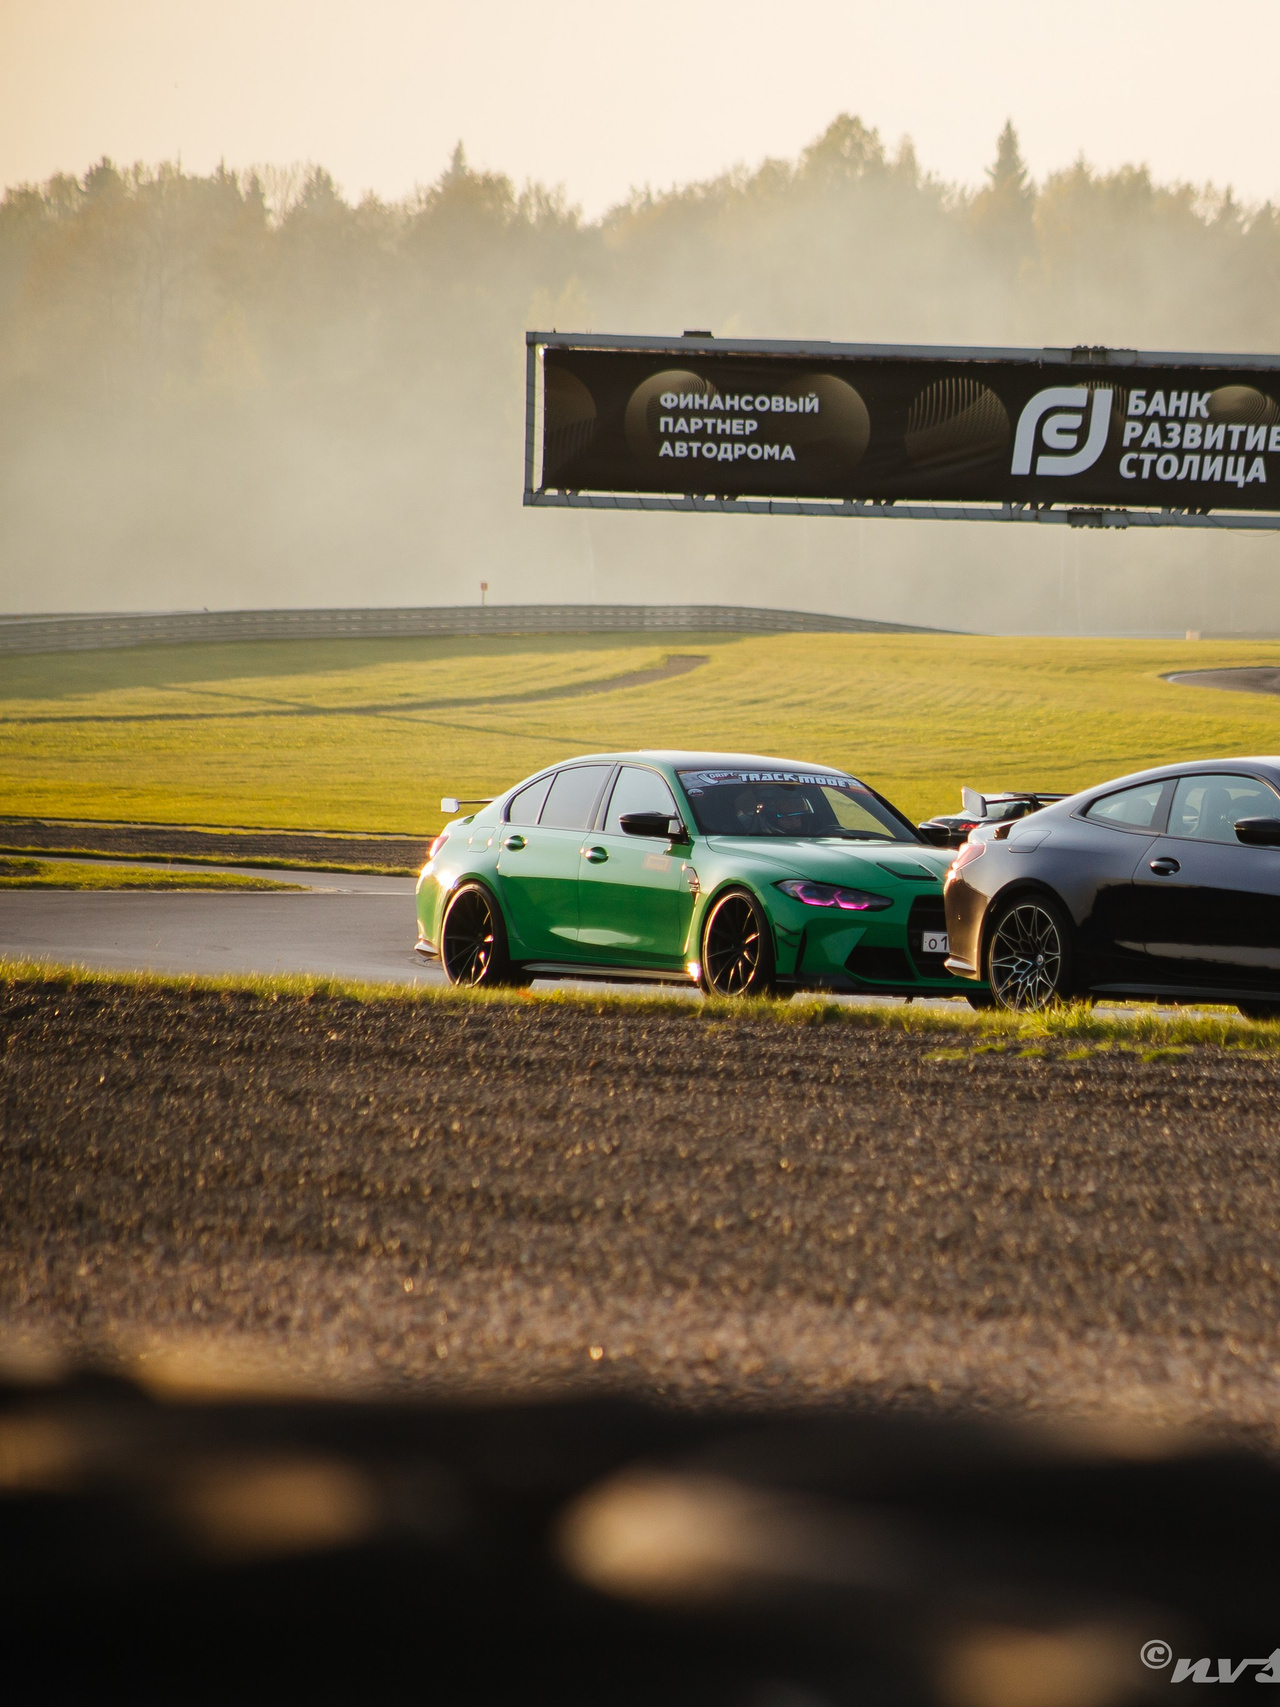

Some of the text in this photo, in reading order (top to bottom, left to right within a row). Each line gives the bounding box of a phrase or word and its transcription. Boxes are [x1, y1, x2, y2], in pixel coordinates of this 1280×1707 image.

[659, 392, 820, 413] ФИНАНСОВЫЙ
[1128, 390, 1212, 417] БАНК
[659, 416, 758, 435] ПАРТНЕР
[658, 441, 796, 462] АВТОДРОМА
[1119, 452, 1267, 487] СТОЛИЦА
[739, 773, 798, 782] TRACK
